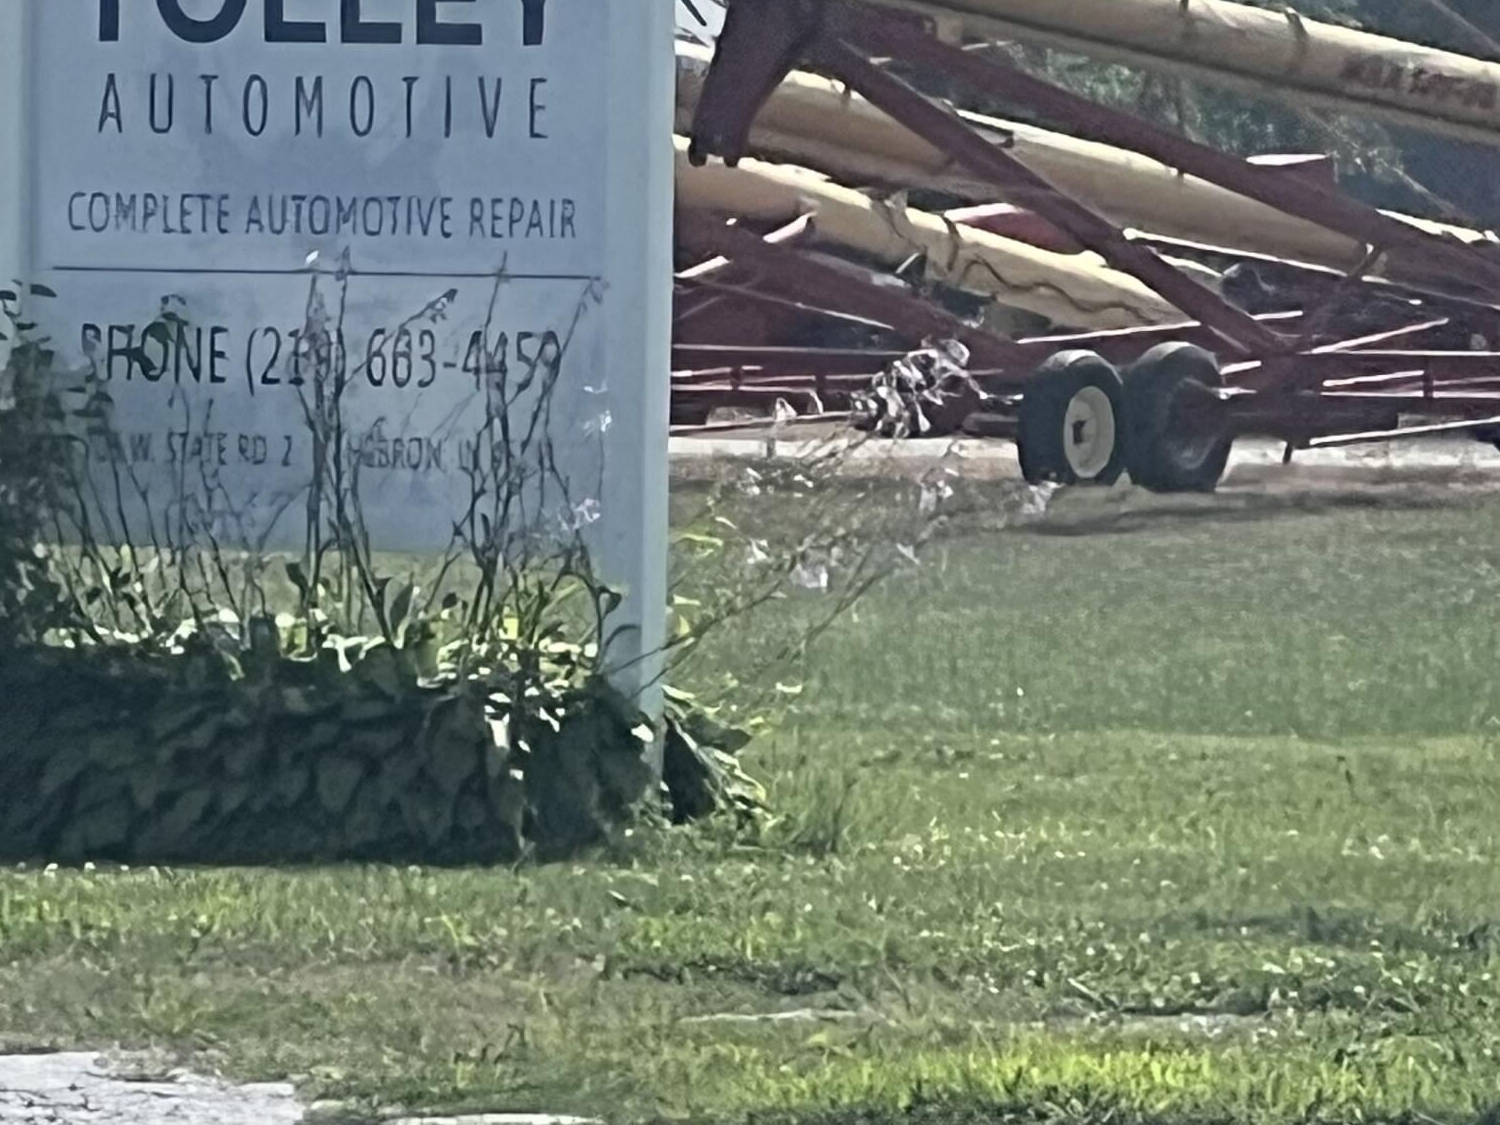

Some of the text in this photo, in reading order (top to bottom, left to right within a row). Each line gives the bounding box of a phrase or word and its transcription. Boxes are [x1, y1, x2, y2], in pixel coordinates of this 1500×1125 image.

[98, 73, 549, 139] AUTOMOTIVE
[67, 191, 577, 240] COMPLETE AUTOMOTIVE REPAIR
[81, 322, 230, 384] PHONE
